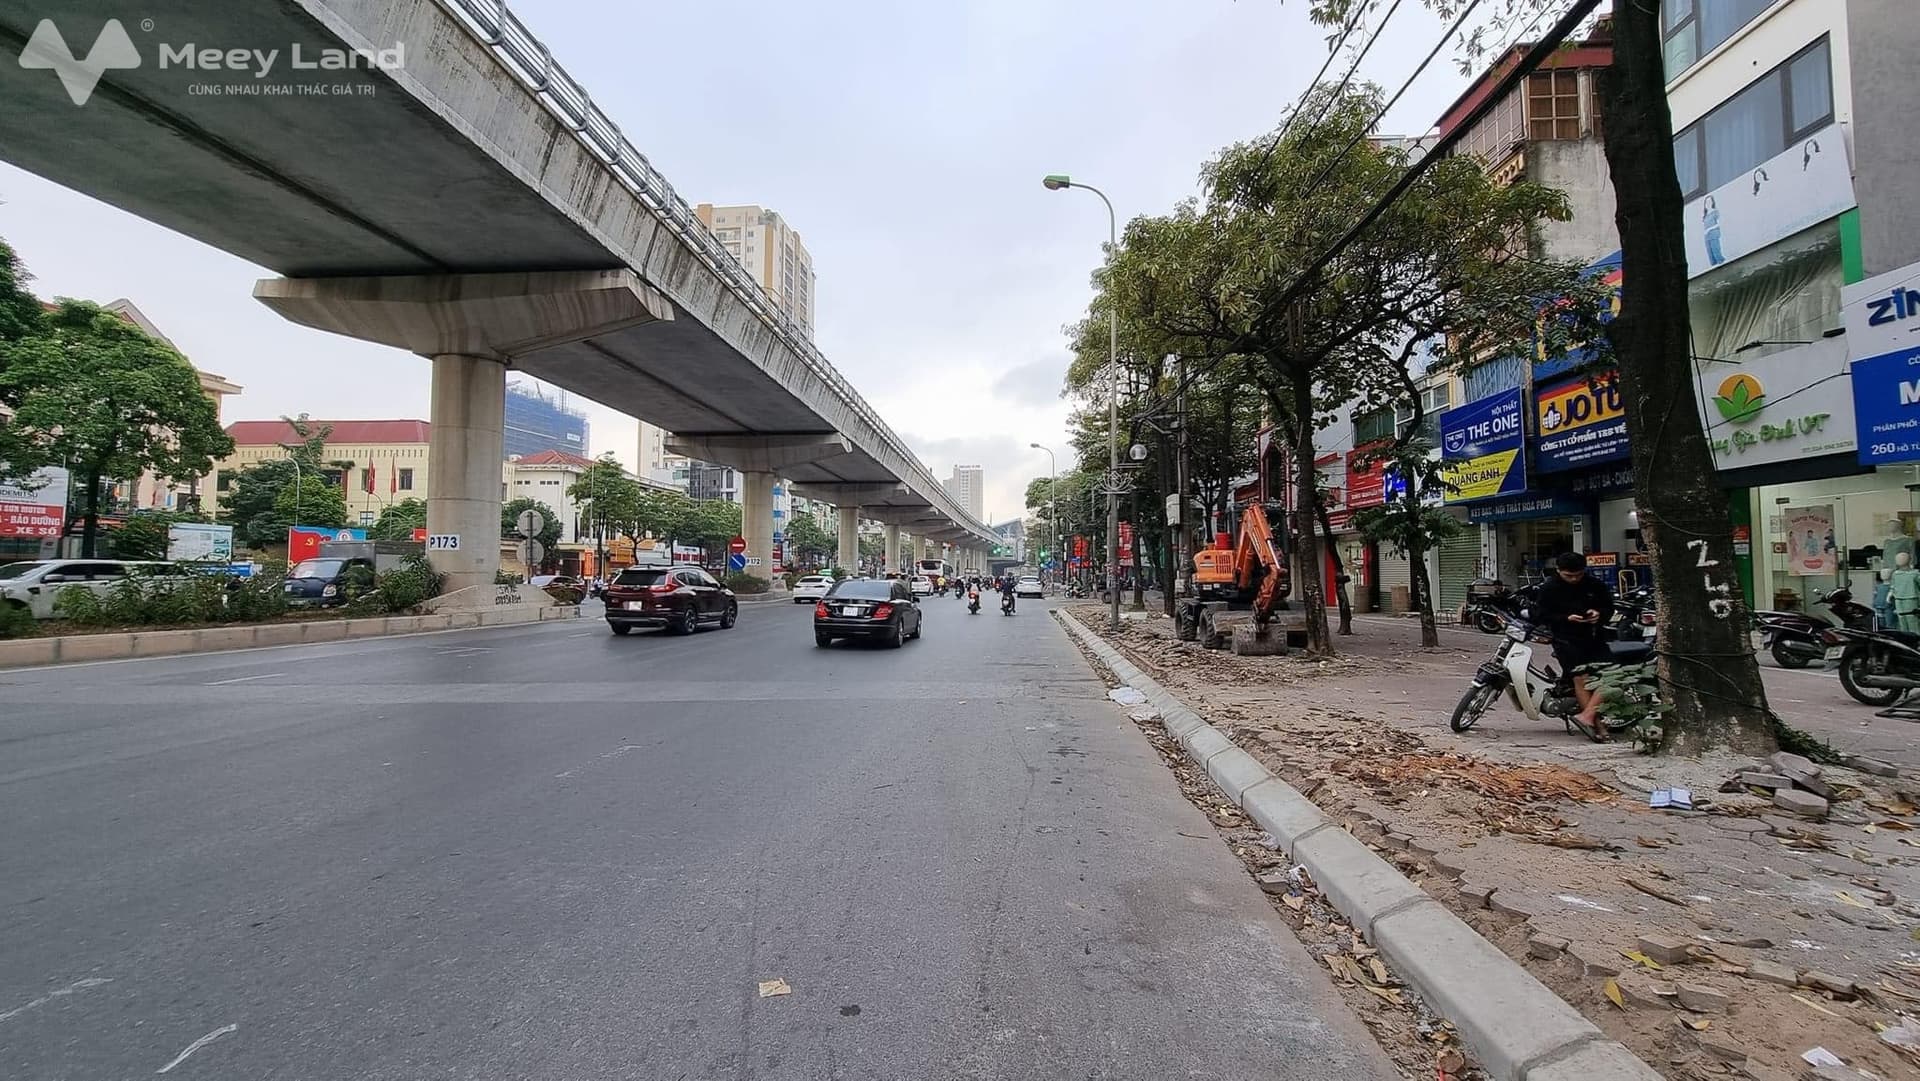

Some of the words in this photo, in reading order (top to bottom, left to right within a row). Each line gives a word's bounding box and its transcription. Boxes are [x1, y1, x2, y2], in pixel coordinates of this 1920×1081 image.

[1563, 379, 1623, 427] JOTU
[1467, 421, 1490, 440] THE
[1492, 412, 1519, 433] ONE
[1871, 442, 1895, 455] 260
[1480, 467, 1500, 481] ANH
[16, 526, 34, 535] XE
[430, 536, 458, 548] P173
